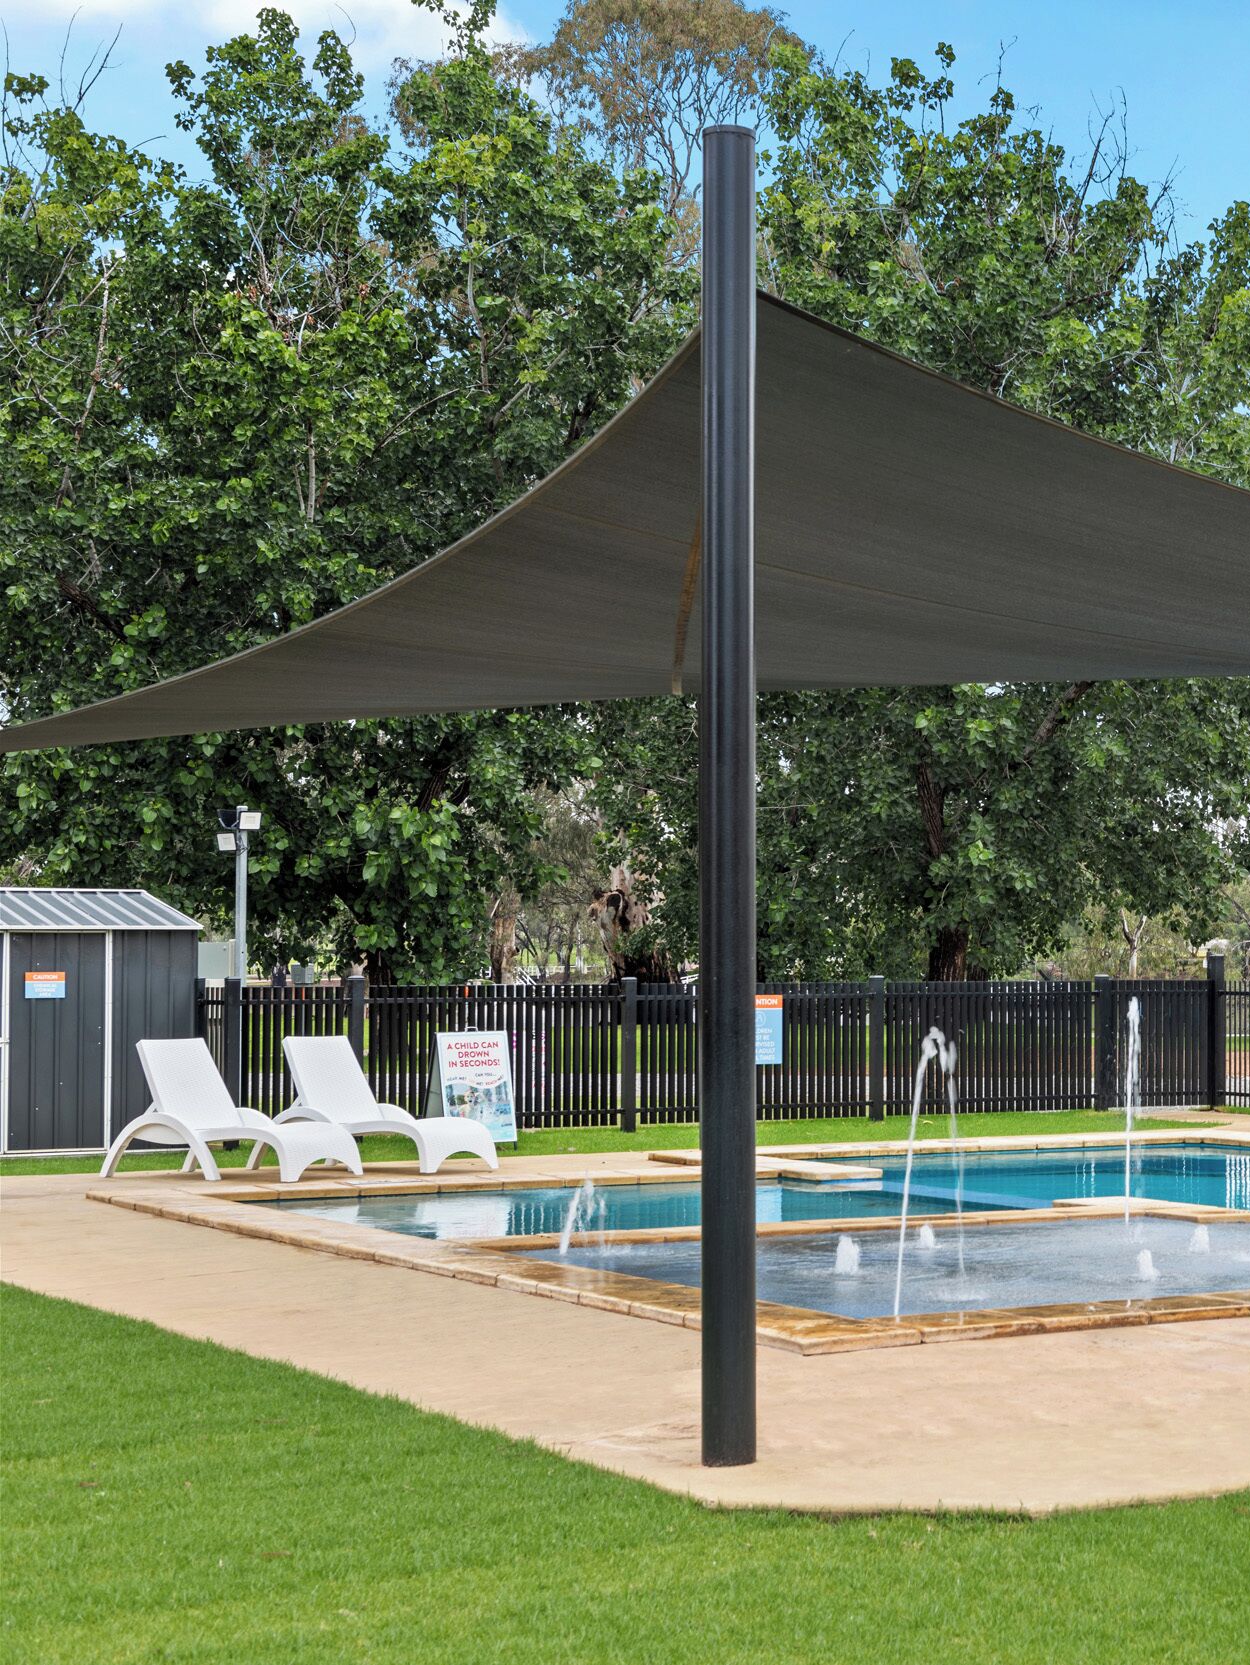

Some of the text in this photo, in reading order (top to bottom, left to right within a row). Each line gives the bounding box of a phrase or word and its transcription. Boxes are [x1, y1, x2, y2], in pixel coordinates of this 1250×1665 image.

[454, 1042, 480, 1050] CHILD
[481, 1041, 499, 1049] CAN
[459, 1059, 501, 1067] SECONDS!
